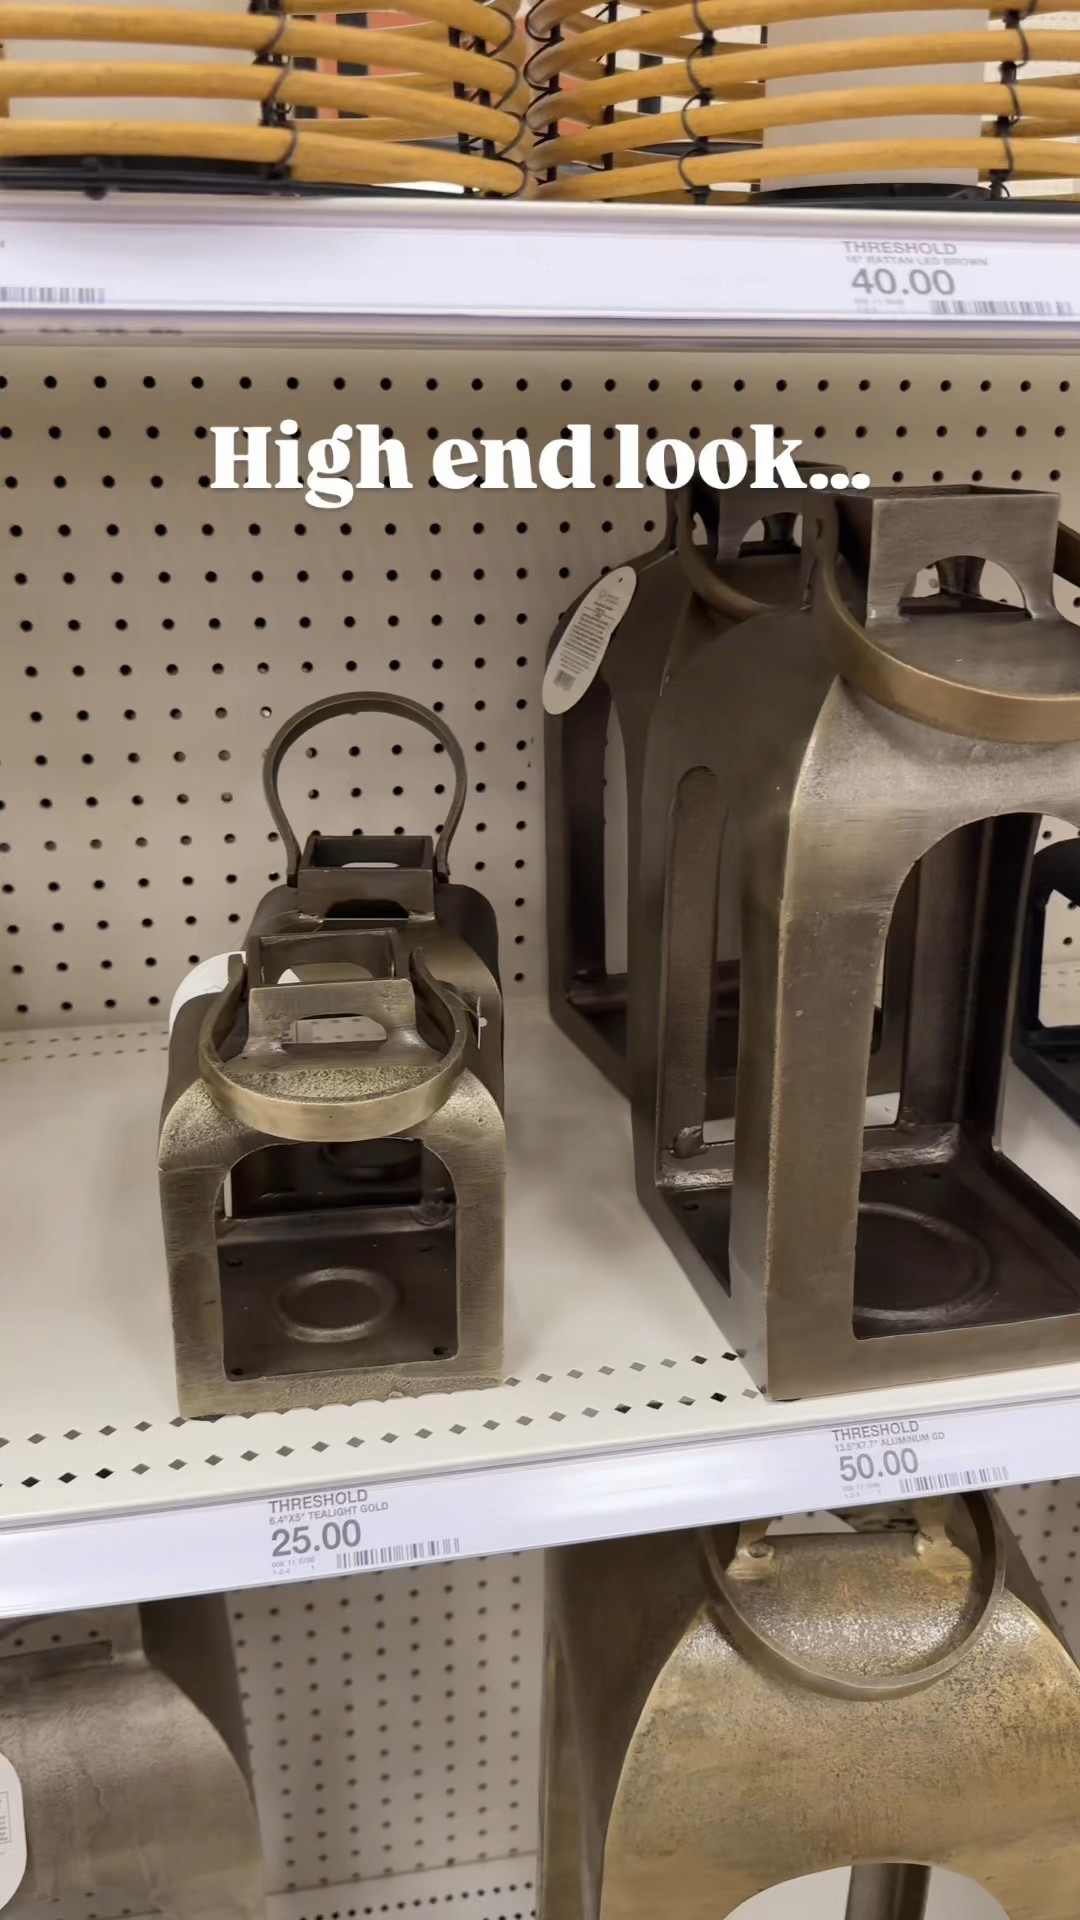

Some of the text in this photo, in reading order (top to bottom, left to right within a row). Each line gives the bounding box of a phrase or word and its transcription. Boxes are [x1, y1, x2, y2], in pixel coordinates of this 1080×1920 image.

[842, 241, 957, 255] THRESHOLD
[851, 268, 955, 295] 40.00
[832, 1420, 919, 1441] THRESHOLD
[881, 1433, 929, 1447] ALUMINUM
[840, 1448, 918, 1481] 50.00
[268, 1489, 368, 1513] THRESHOLD
[307, 1505, 357, 1520] TEALIGHT
[360, 1502, 389, 1513] GOLD
[272, 1519, 361, 1558] 25.00
